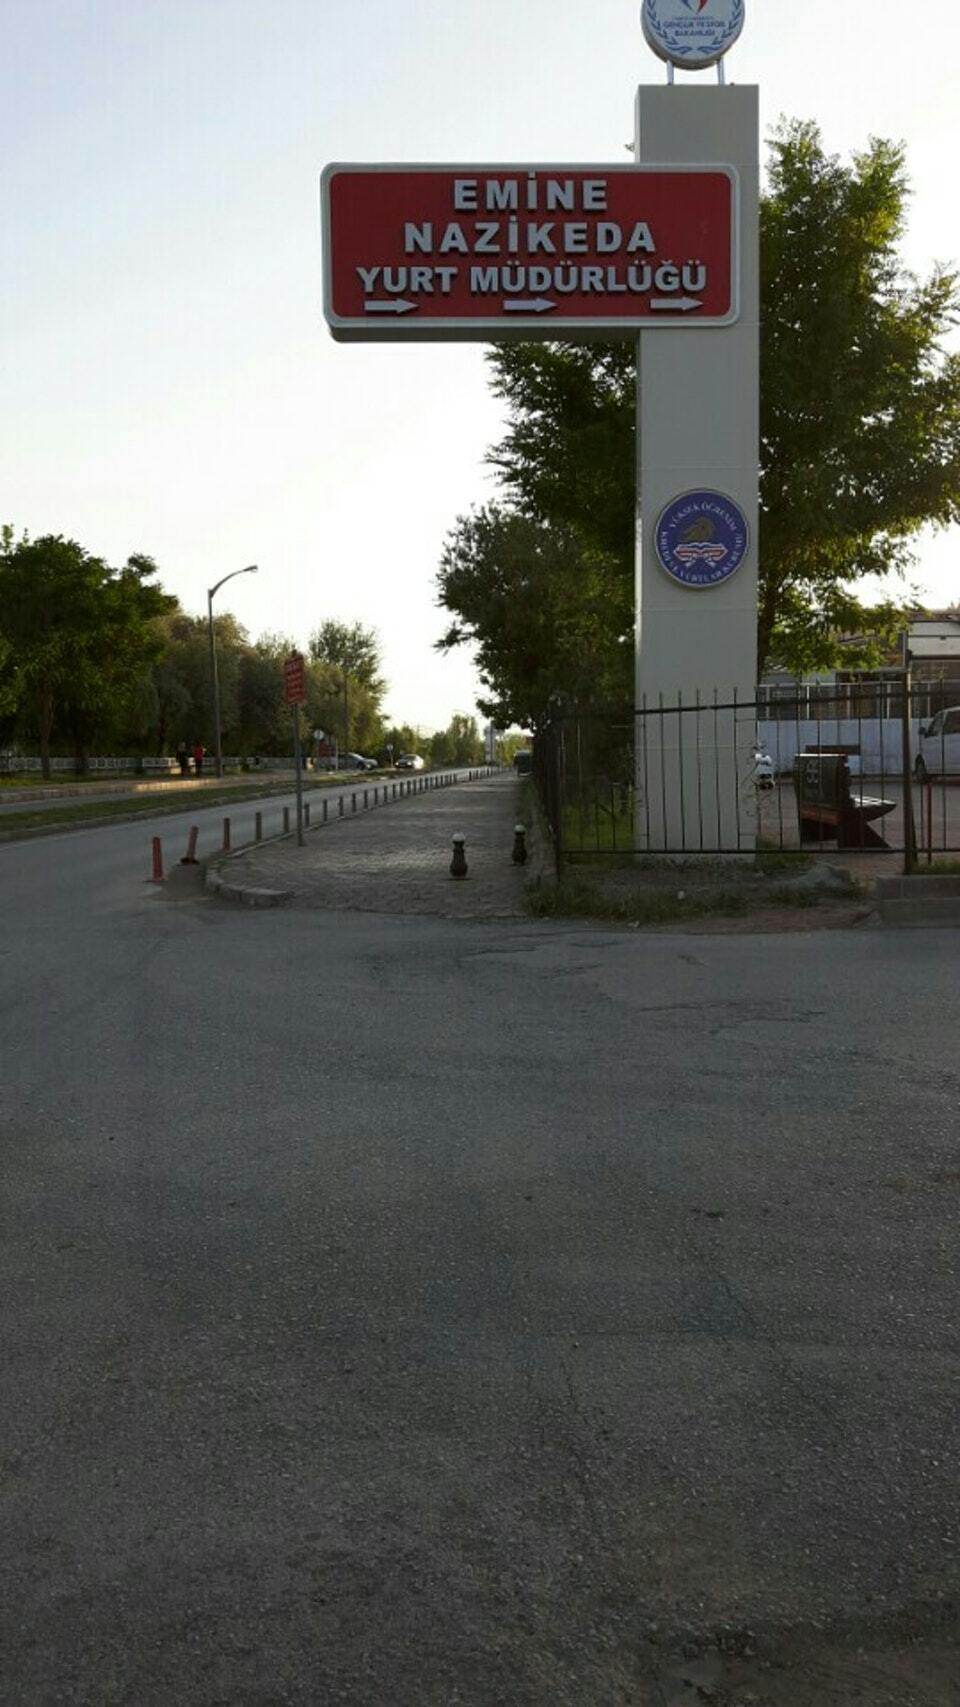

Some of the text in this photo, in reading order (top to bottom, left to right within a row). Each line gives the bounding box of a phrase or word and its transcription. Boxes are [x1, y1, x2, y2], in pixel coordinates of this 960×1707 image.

[453, 171, 609, 210] EMİNE
[404, 215, 656, 253] NAZİKEDA
[356, 259, 707, 293] YURT MÜDÜRLÜĞÜ
